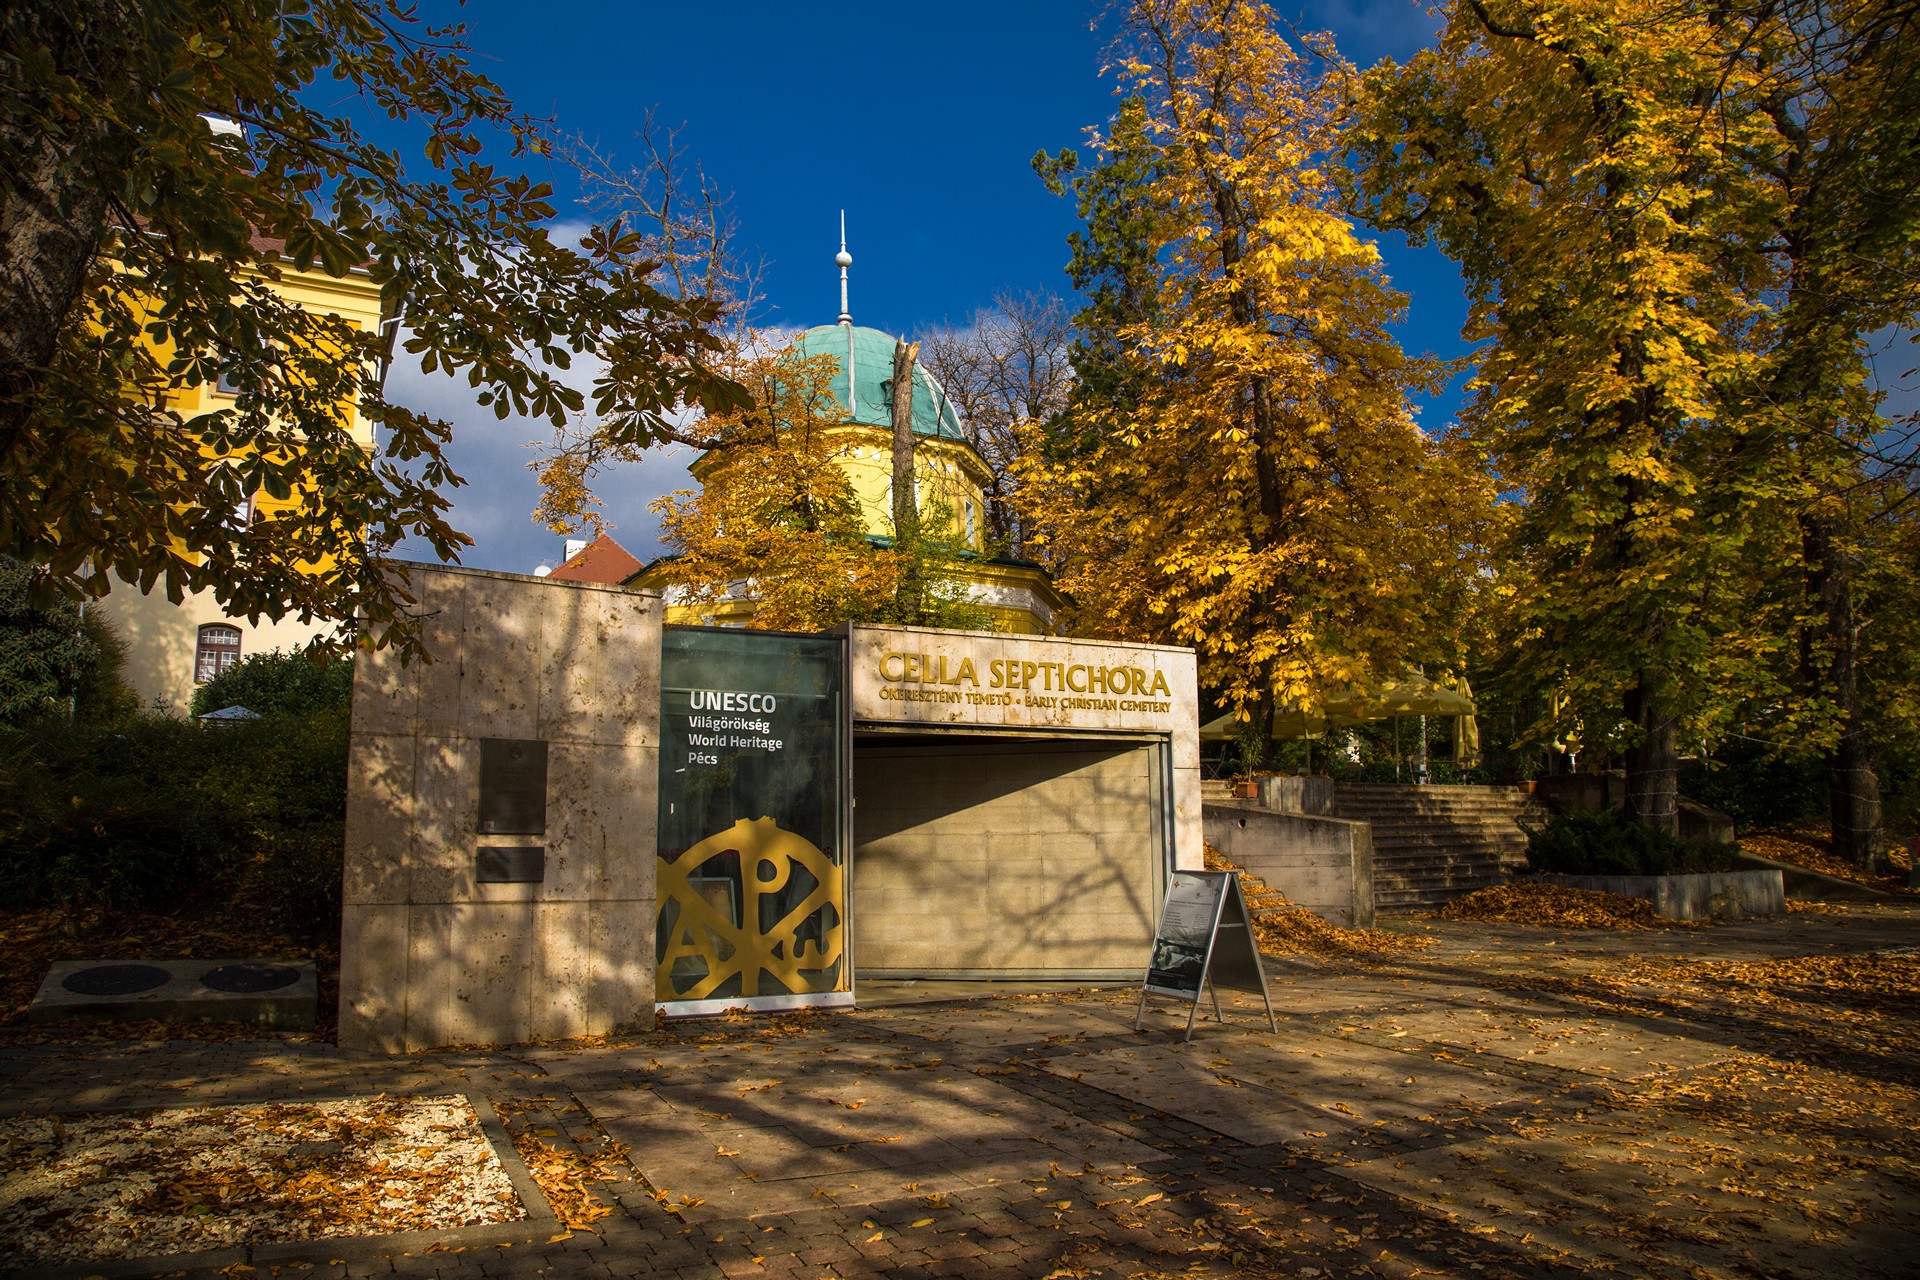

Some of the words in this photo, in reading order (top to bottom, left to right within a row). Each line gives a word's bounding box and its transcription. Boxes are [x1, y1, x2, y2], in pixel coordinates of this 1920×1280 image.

[879, 652, 980, 687] CELLA
[989, 659, 1171, 697] SEPTICHORA
[690, 690, 777, 714] UNESCO
[879, 686, 962, 704] ÓKERESZTÉNY
[965, 691, 1012, 706] TEMETŐ
[1025, 695, 1058, 708] EARLY
[1060, 697, 1117, 711] CHRISTIAN
[1120, 700, 1171, 713] CEMETERY
[688, 715, 770, 734] Világörökség
[688, 733, 727, 747] World
[730, 735, 783, 752] Heritage
[688, 751, 718, 765] Pécs
